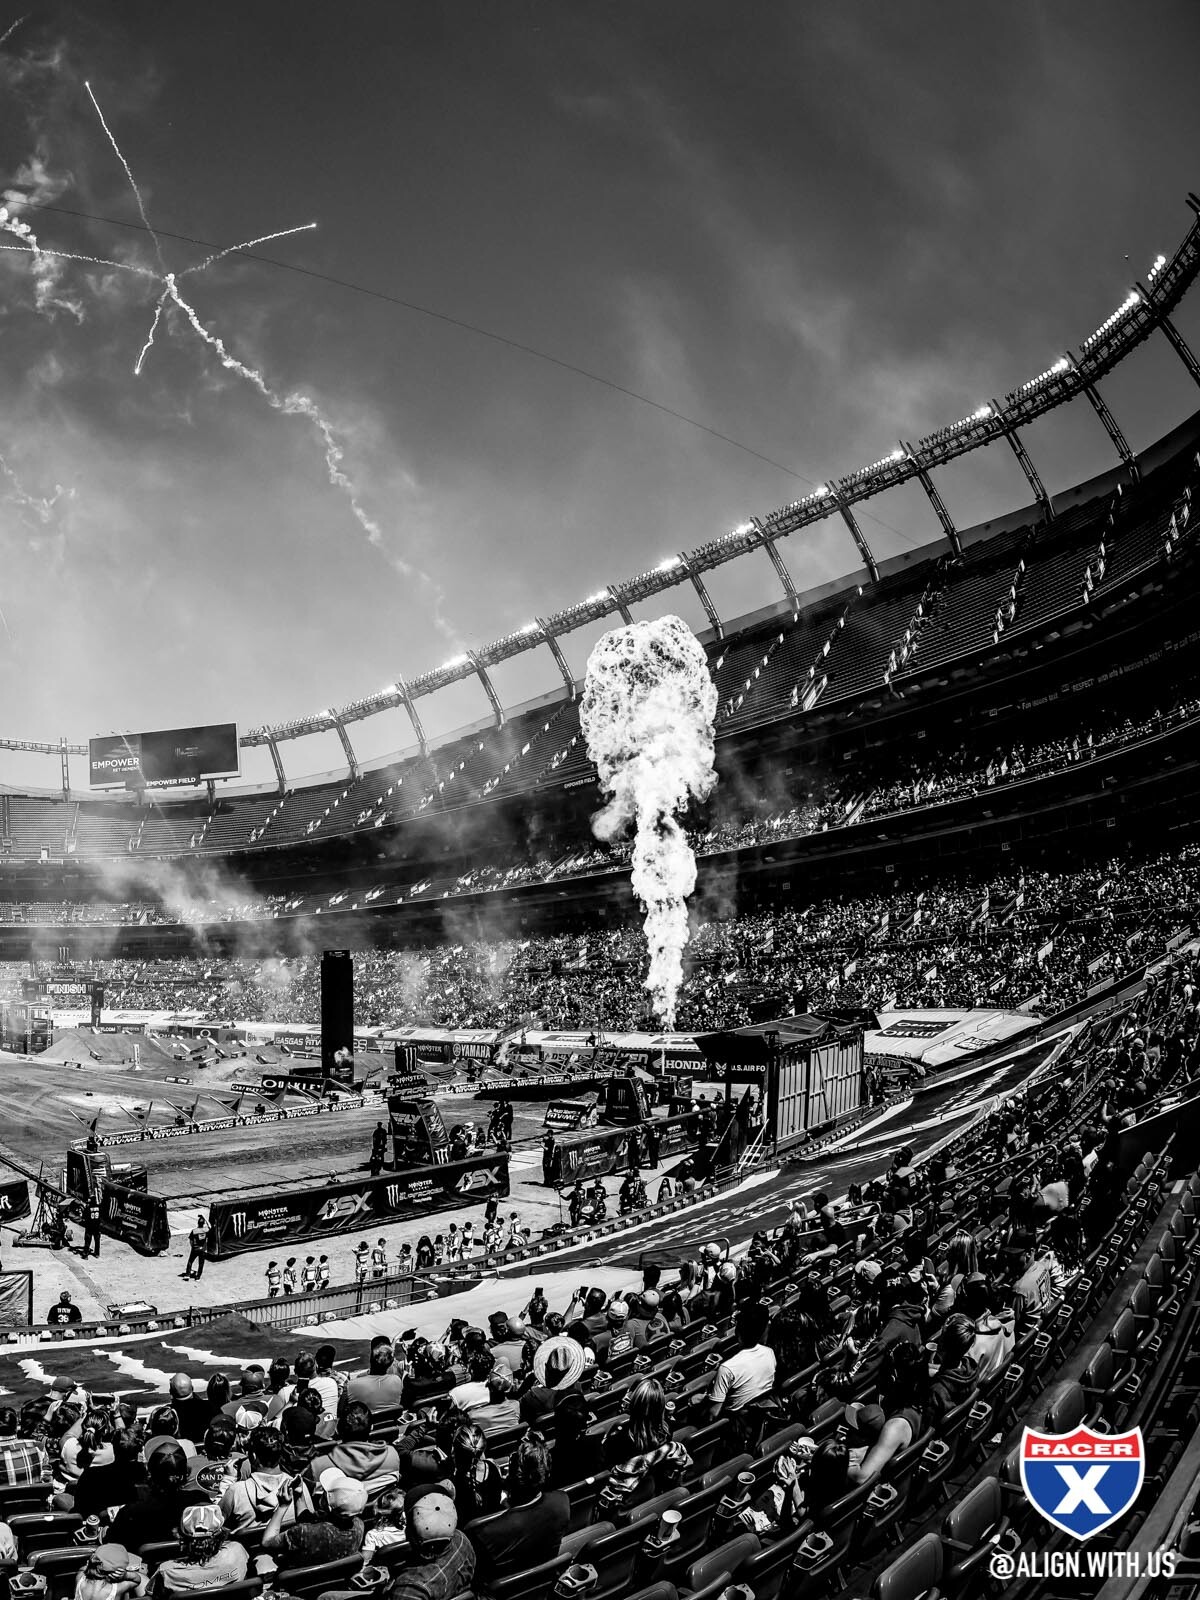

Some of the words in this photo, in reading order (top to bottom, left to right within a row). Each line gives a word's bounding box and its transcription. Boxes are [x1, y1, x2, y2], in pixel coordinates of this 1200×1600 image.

[92, 757, 140, 770] EMPOWER
[146, 779, 177, 787] EMPOWER
[47, 984, 86, 994] FINISH
[275, 1037, 303, 1045] GASGAS
[461, 1044, 491, 1058] YAMAHA
[665, 1059, 707, 1071] HONDA
[408, 1180, 434, 1190] MONSTER
[399, 1187, 445, 1201] SUPERCROSS
[258, 1207, 288, 1217] MONSTER
[246, 1215, 302, 1231] SUPERCROSS
